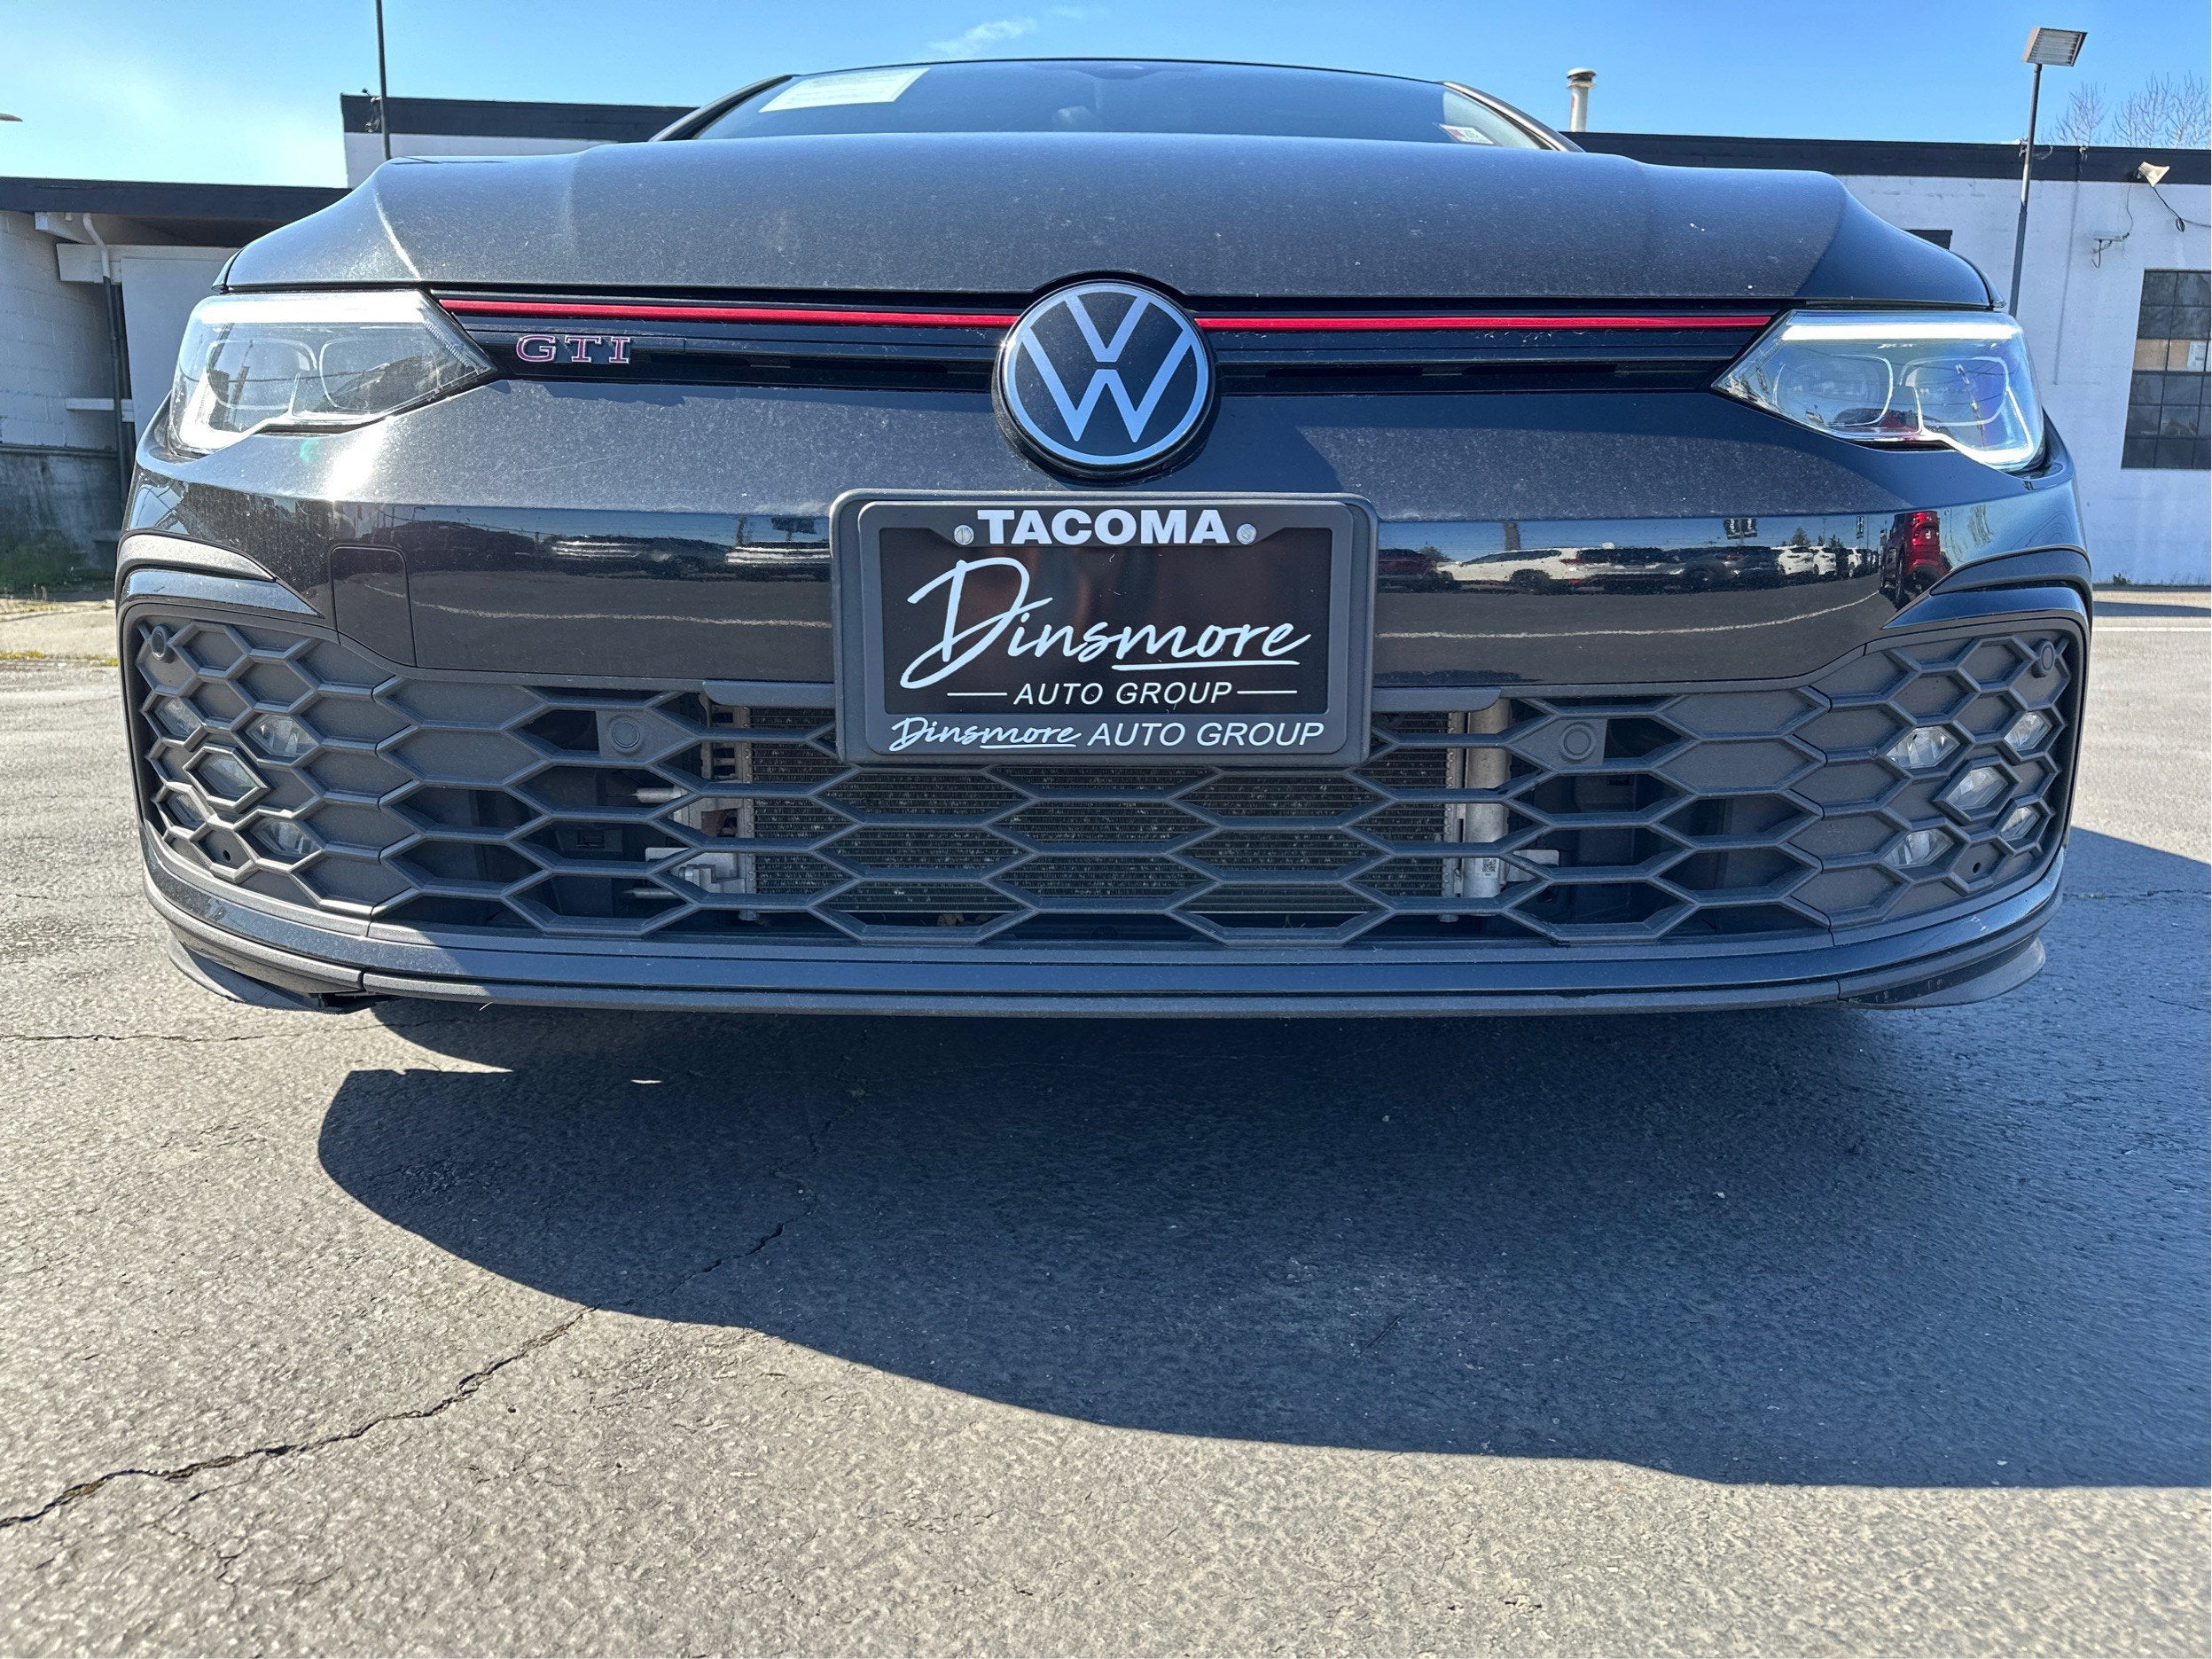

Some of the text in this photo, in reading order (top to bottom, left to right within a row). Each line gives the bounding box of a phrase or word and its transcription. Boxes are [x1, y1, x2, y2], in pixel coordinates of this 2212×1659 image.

[516, 333, 631, 364] GTI
[1018, 290, 1199, 443] VW
[977, 508, 1231, 545] TACOMA
[900, 557, 1312, 689] Dinsmore
[1012, 681, 1232, 705] AUTO GROUP
[888, 716, 1325, 751] Dinsmore AUTO GROUP
